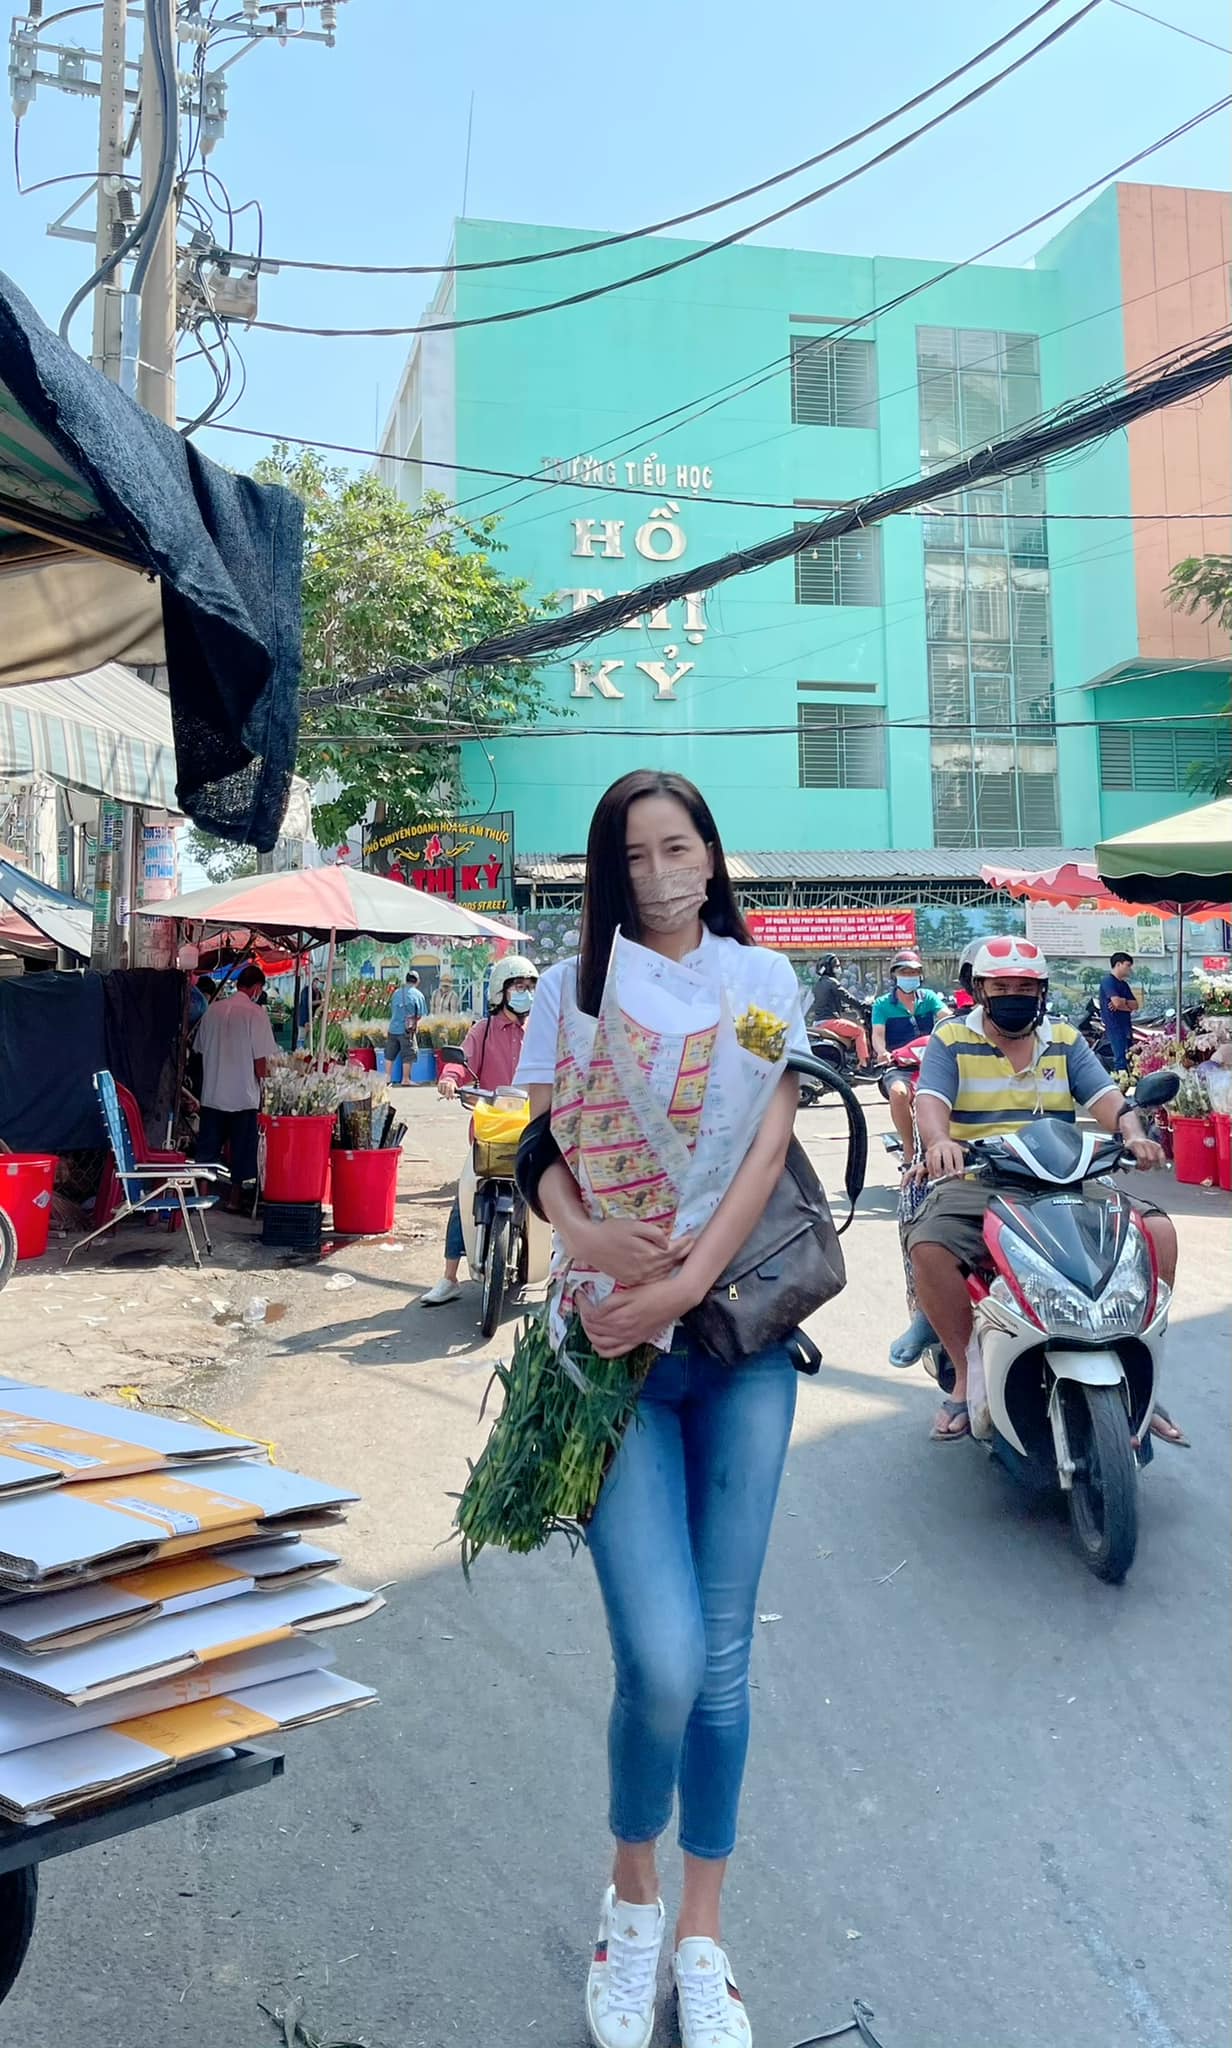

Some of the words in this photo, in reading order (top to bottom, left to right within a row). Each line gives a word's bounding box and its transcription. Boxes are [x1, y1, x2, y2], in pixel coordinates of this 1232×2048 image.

[625, 452, 666, 486] TIỂU
[676, 464, 713, 495] HỌC
[570, 501, 687, 561] HỒ
[570, 644, 696, 701] KỶ
[379, 827, 411, 848] CHUYÊN
[412, 867, 455, 899] THỊ
[462, 854, 502, 891] KỶ
[477, 900, 508, 911] STREET
